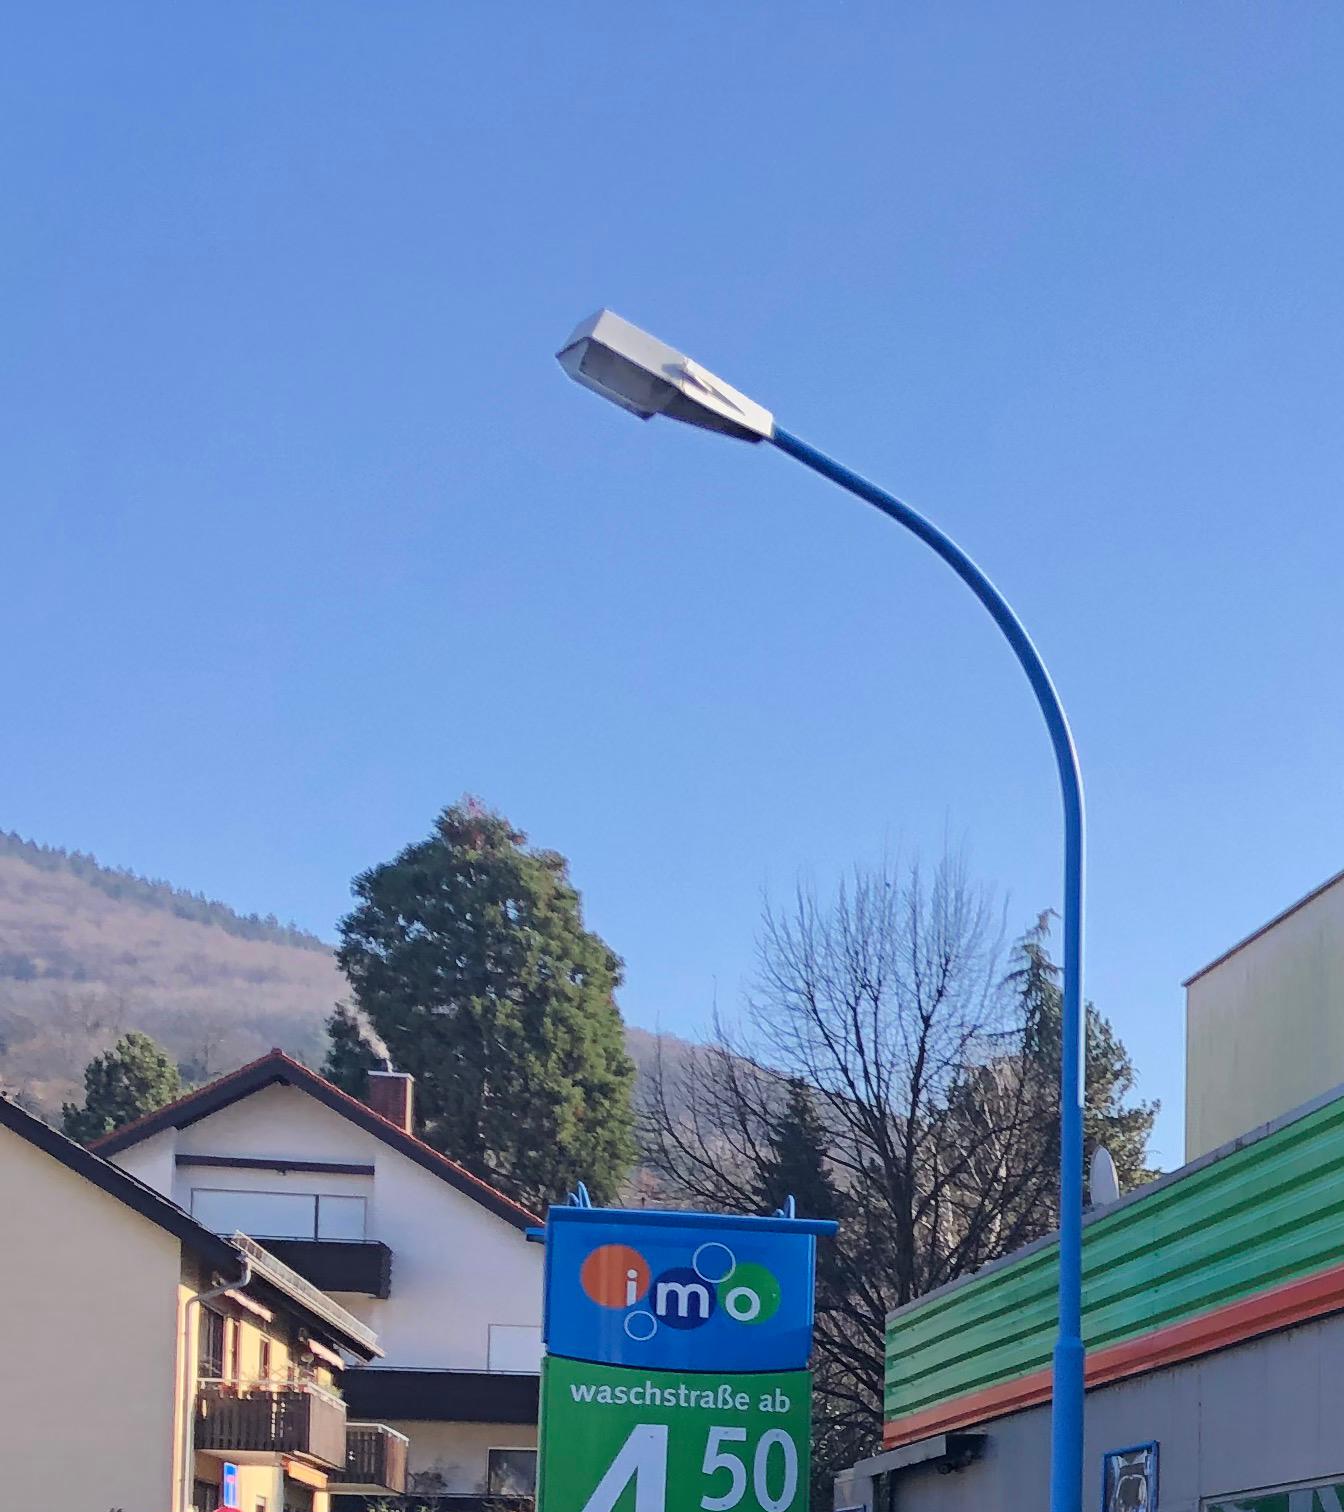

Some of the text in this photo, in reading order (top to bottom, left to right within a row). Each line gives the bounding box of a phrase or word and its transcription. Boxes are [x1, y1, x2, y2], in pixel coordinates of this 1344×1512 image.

[625, 1268, 761, 1322] imo
[570, 1381, 791, 1413] waschstraße ab
